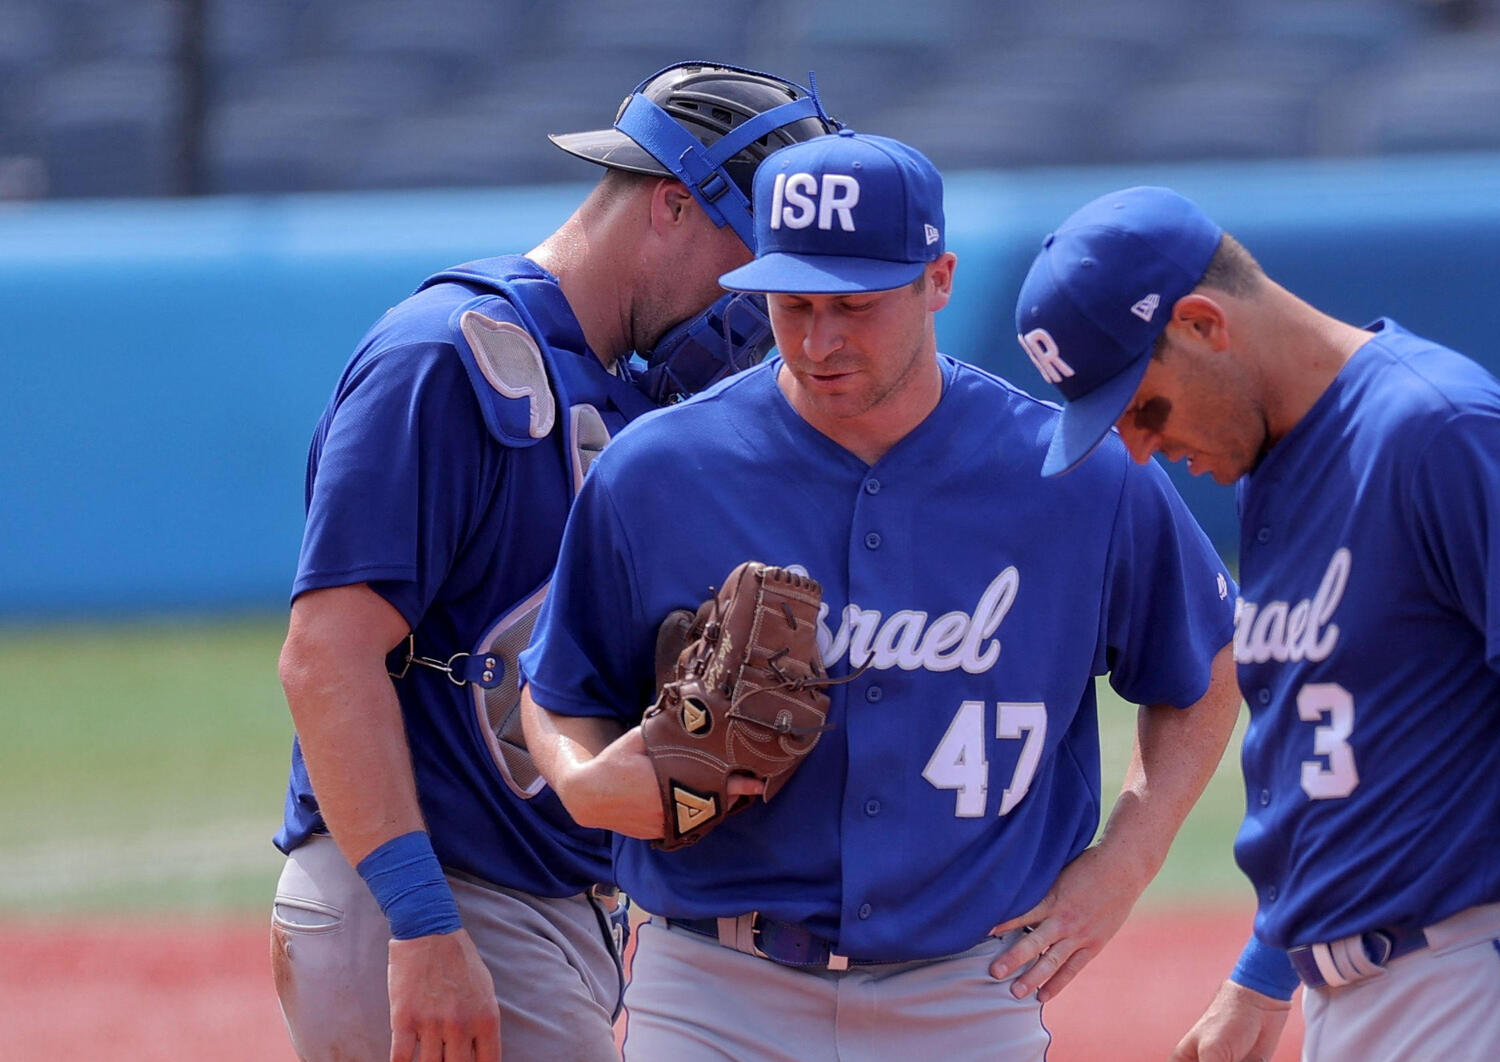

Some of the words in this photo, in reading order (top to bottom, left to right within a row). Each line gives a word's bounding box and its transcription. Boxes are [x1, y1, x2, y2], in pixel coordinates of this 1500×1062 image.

[770, 172, 860, 232] ISR
[922, 700, 1048, 818] 47
[1299, 683, 1360, 800] 3
